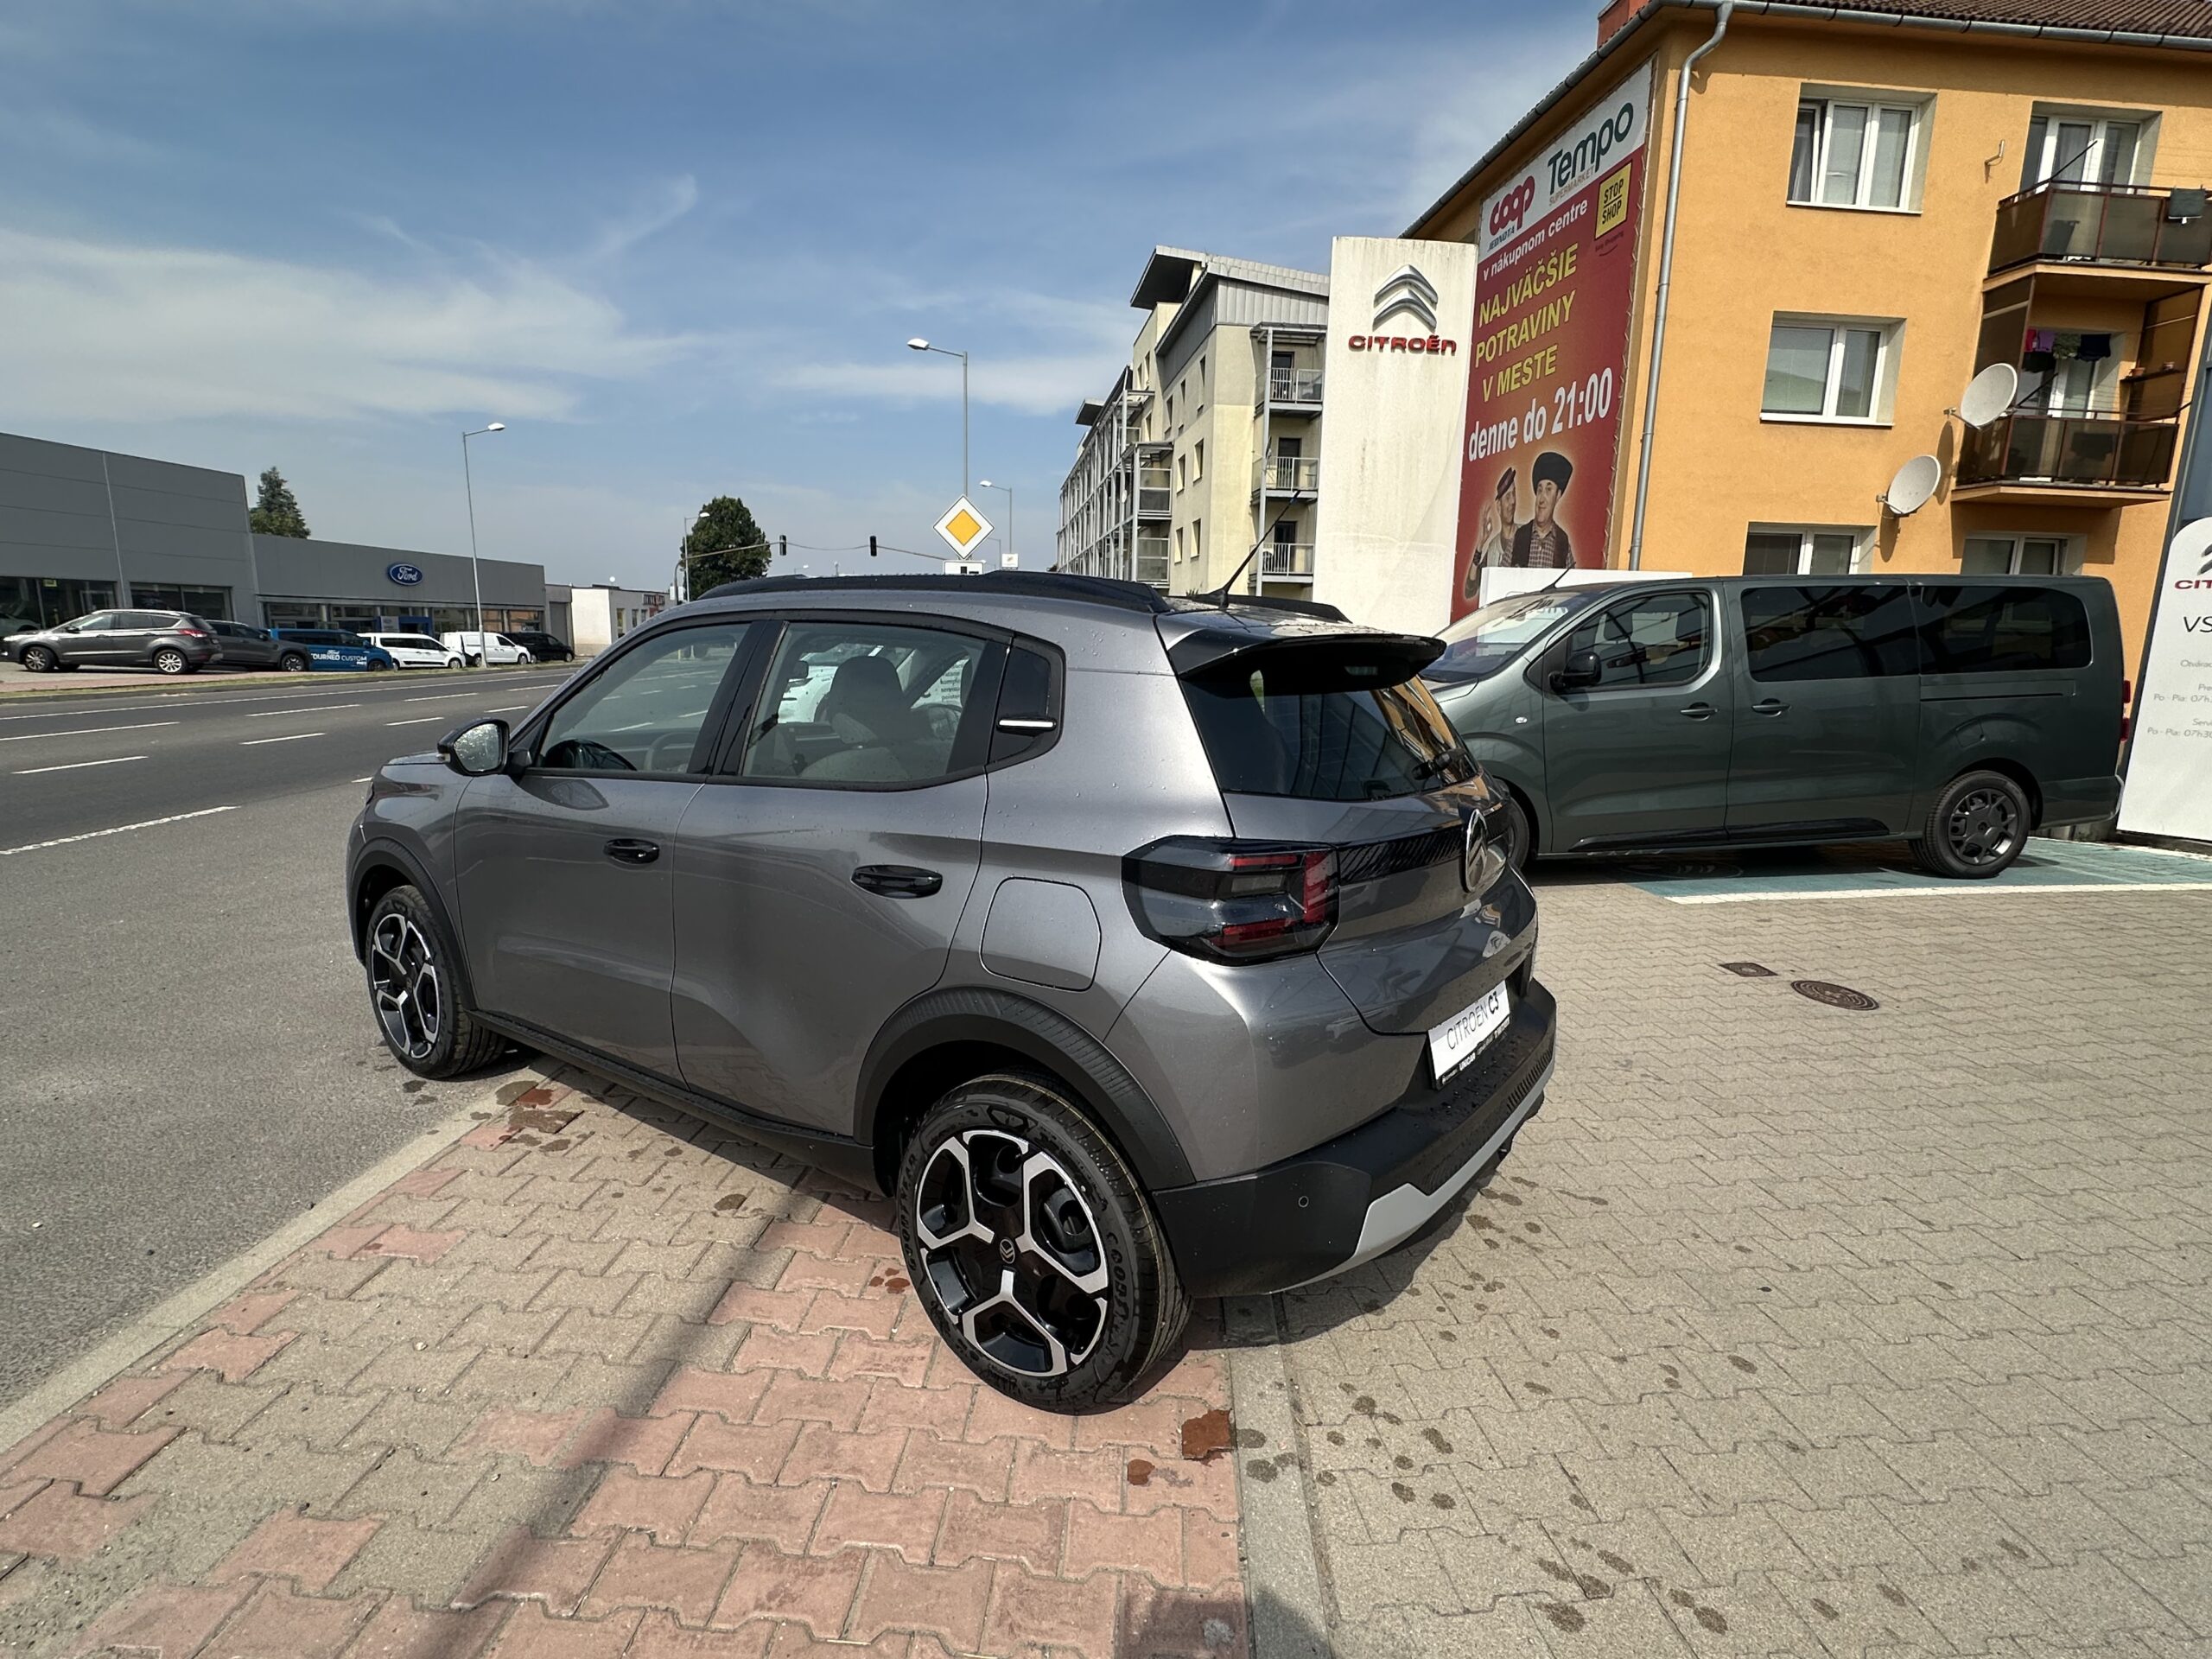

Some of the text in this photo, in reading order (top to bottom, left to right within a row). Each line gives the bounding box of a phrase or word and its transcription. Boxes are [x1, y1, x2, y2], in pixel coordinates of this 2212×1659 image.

[1548, 102, 1634, 196] Tempo
[1489, 175, 1535, 236] coop
[1602, 200, 1622, 225] SHOP
[1604, 178, 1624, 204] STOP
[1491, 229, 1545, 276] nákupnom
[1548, 200, 1588, 238] centre
[1478, 243, 1579, 328] NAJVÄČŠIE
[1475, 289, 1576, 368] POTRAVINY
[1483, 345, 1558, 403] V MESTE
[1469, 367, 1612, 462] denne do 21:00
[397, 566, 418, 582] Ford
[2190, 695, 2212, 703] 07h
[1488, 991, 1499, 1014] C3
